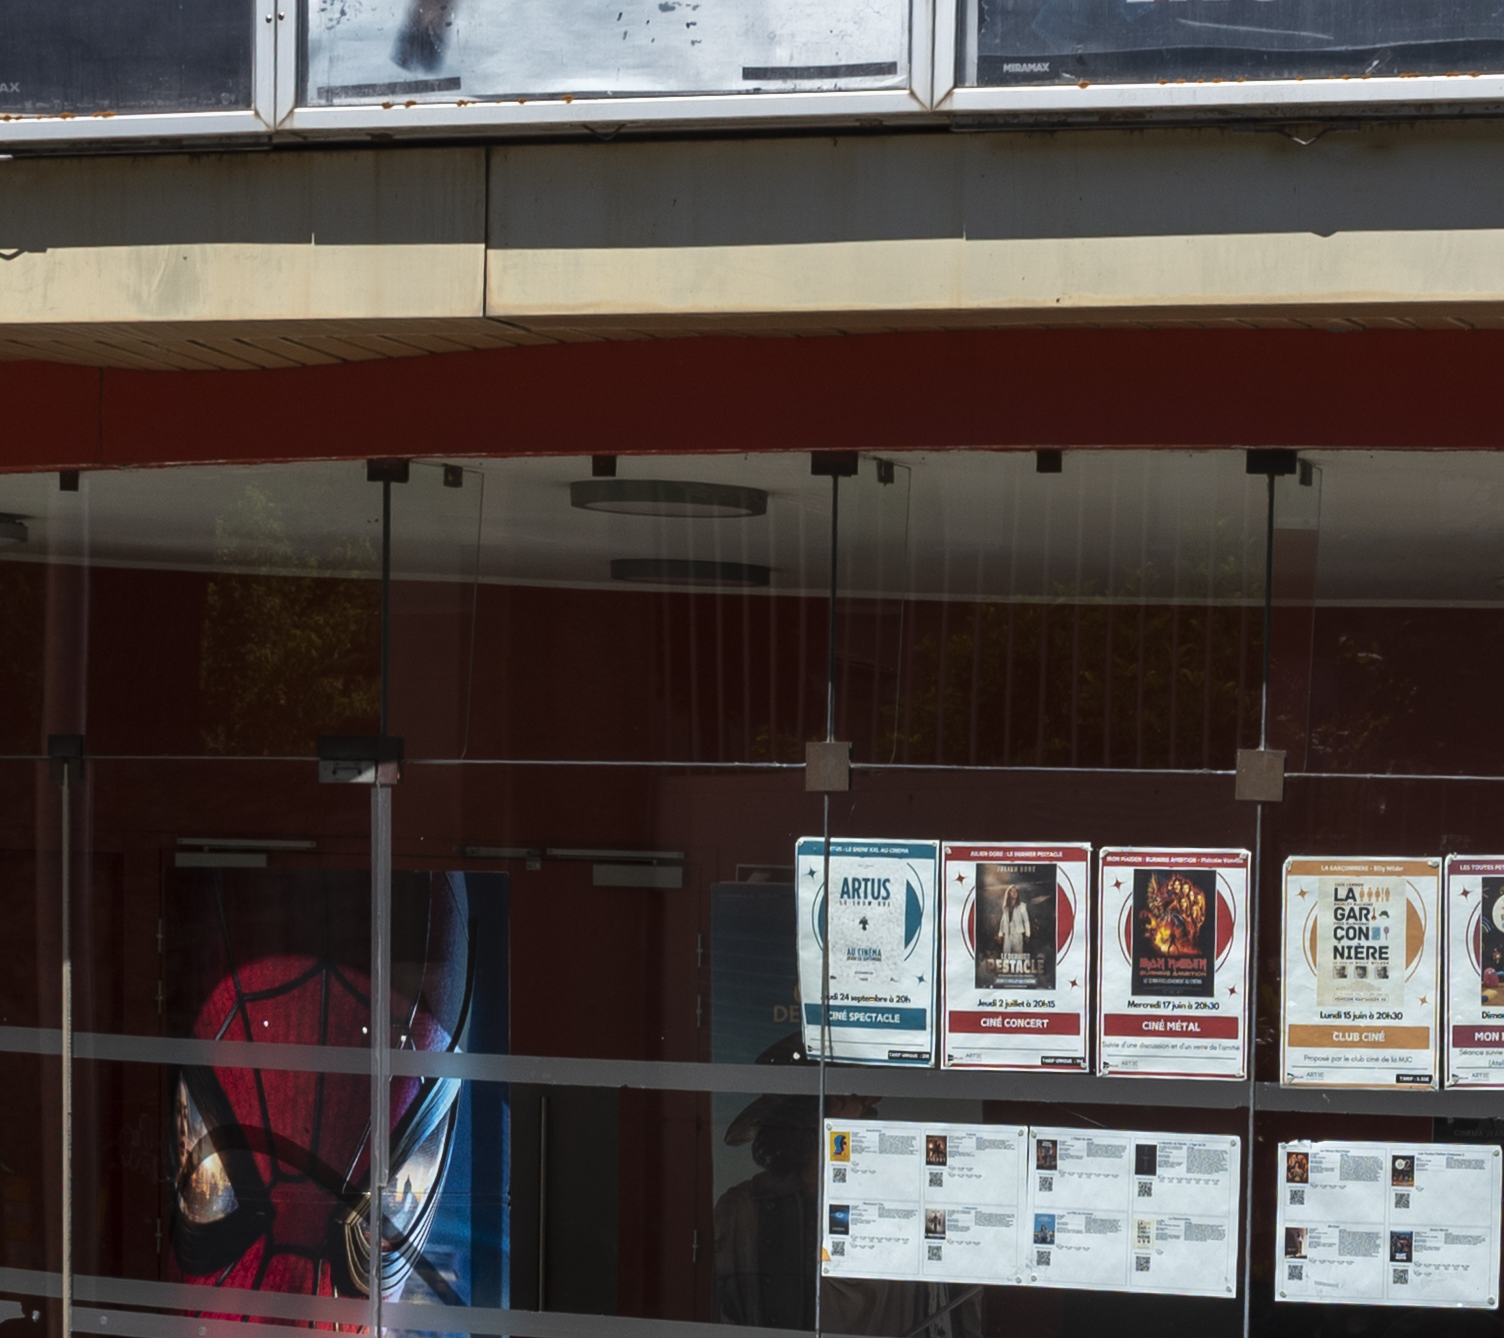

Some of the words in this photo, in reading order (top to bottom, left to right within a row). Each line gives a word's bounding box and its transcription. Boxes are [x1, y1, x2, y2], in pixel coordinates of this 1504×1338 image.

[1003, 62, 1049, 73] MIRAMAX
[840, 877, 891, 900] ARTUS
[1334, 888, 1356, 901] LA
[1334, 907, 1370, 921] GAR
[1334, 926, 1369, 943] ÇON
[1333, 942, 1389, 960] NIÈRE
[851, 994, 888, 1003] septembre
[977, 999, 997, 1007] Jeudi
[1004, 1000, 1024, 1009] juillet
[1127, 1000, 1161, 1009] Mercredi
[1172, 1001, 1186, 1011] juin
[1195, 1002, 1219, 1010] 20h30
[849, 1012, 900, 1023] SPECTACLE
[1320, 1011, 1342, 1019] Lundi
[1352, 1012, 1367, 1021] juin
[1376, 1012, 1403, 1020] 20h30
[981, 1016, 1002, 1027] CINÉ
[1004, 1018, 1049, 1028] CONCERT
[1142, 1019, 1165, 1031] CINÉ
[1167, 1019, 1201, 1031] MÉTAL
[1333, 1031, 1359, 1041] CLUB
[1362, 1030, 1385, 1042] CINÉ
[1475, 1032, 1499, 1041] MON
[1304, 1055, 1329, 1063] Proposé
